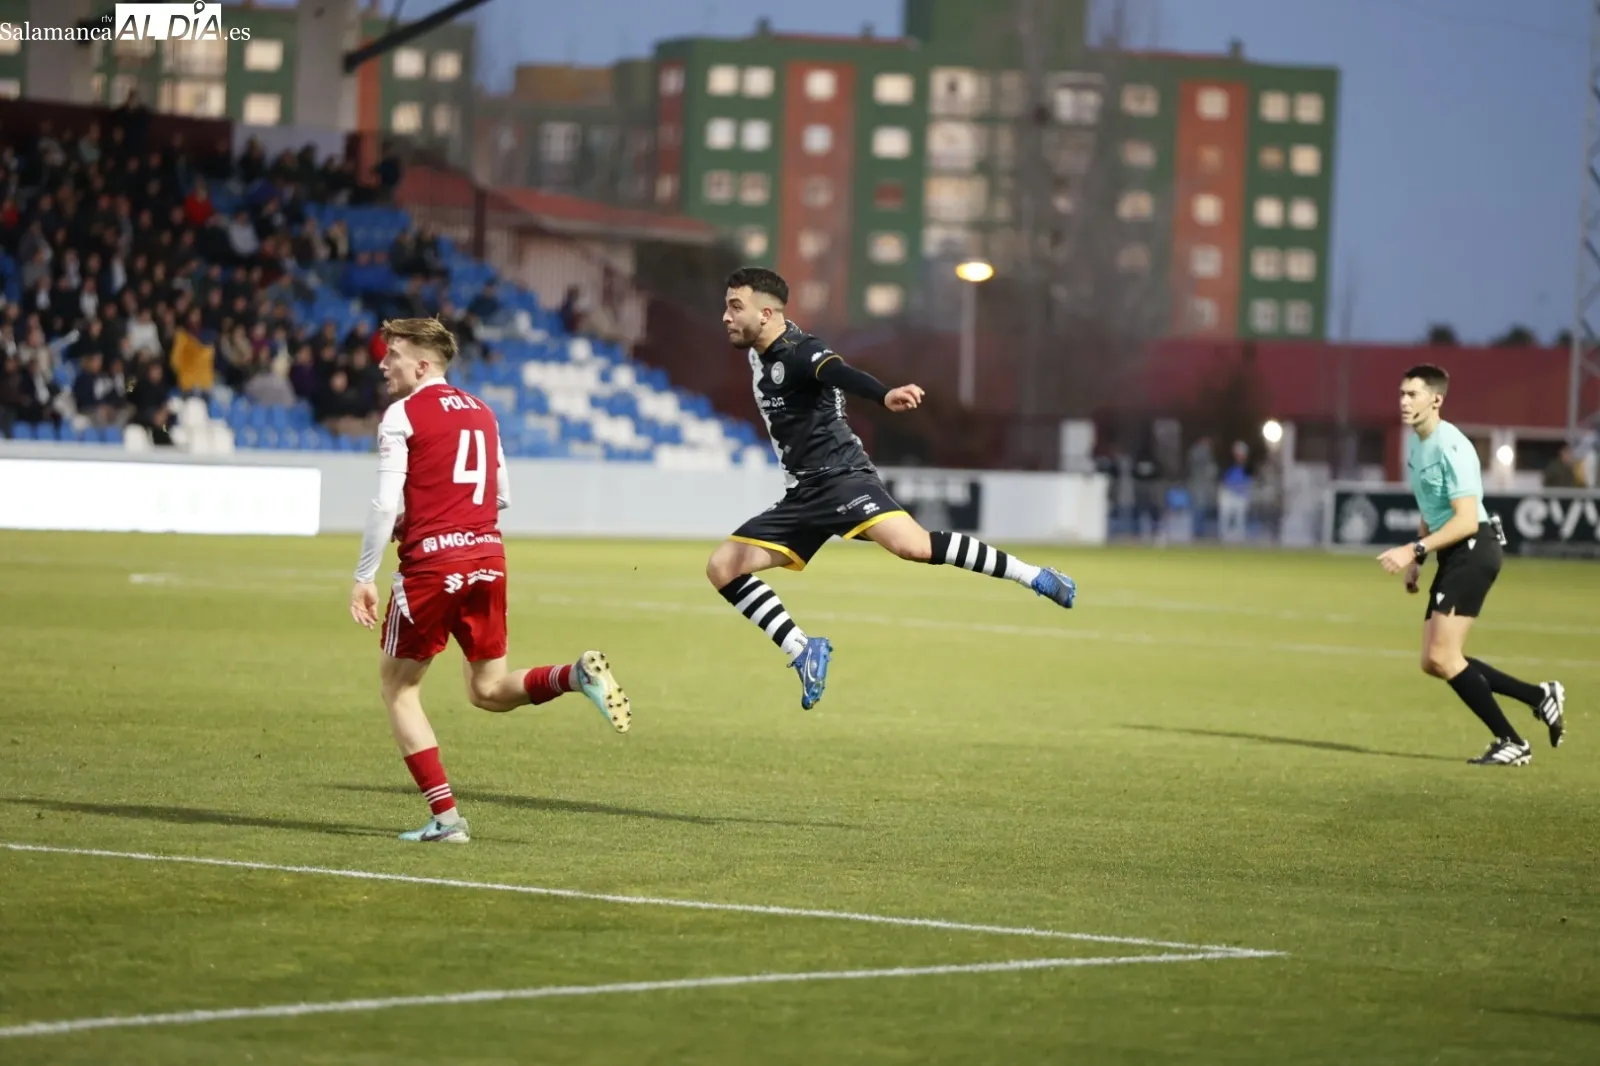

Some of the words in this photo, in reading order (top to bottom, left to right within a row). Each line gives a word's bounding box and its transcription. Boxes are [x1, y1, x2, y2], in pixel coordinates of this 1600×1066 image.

[439, 395, 469, 412] POL
[453, 429, 487, 506] 4
[438, 531, 475, 549] MGC
